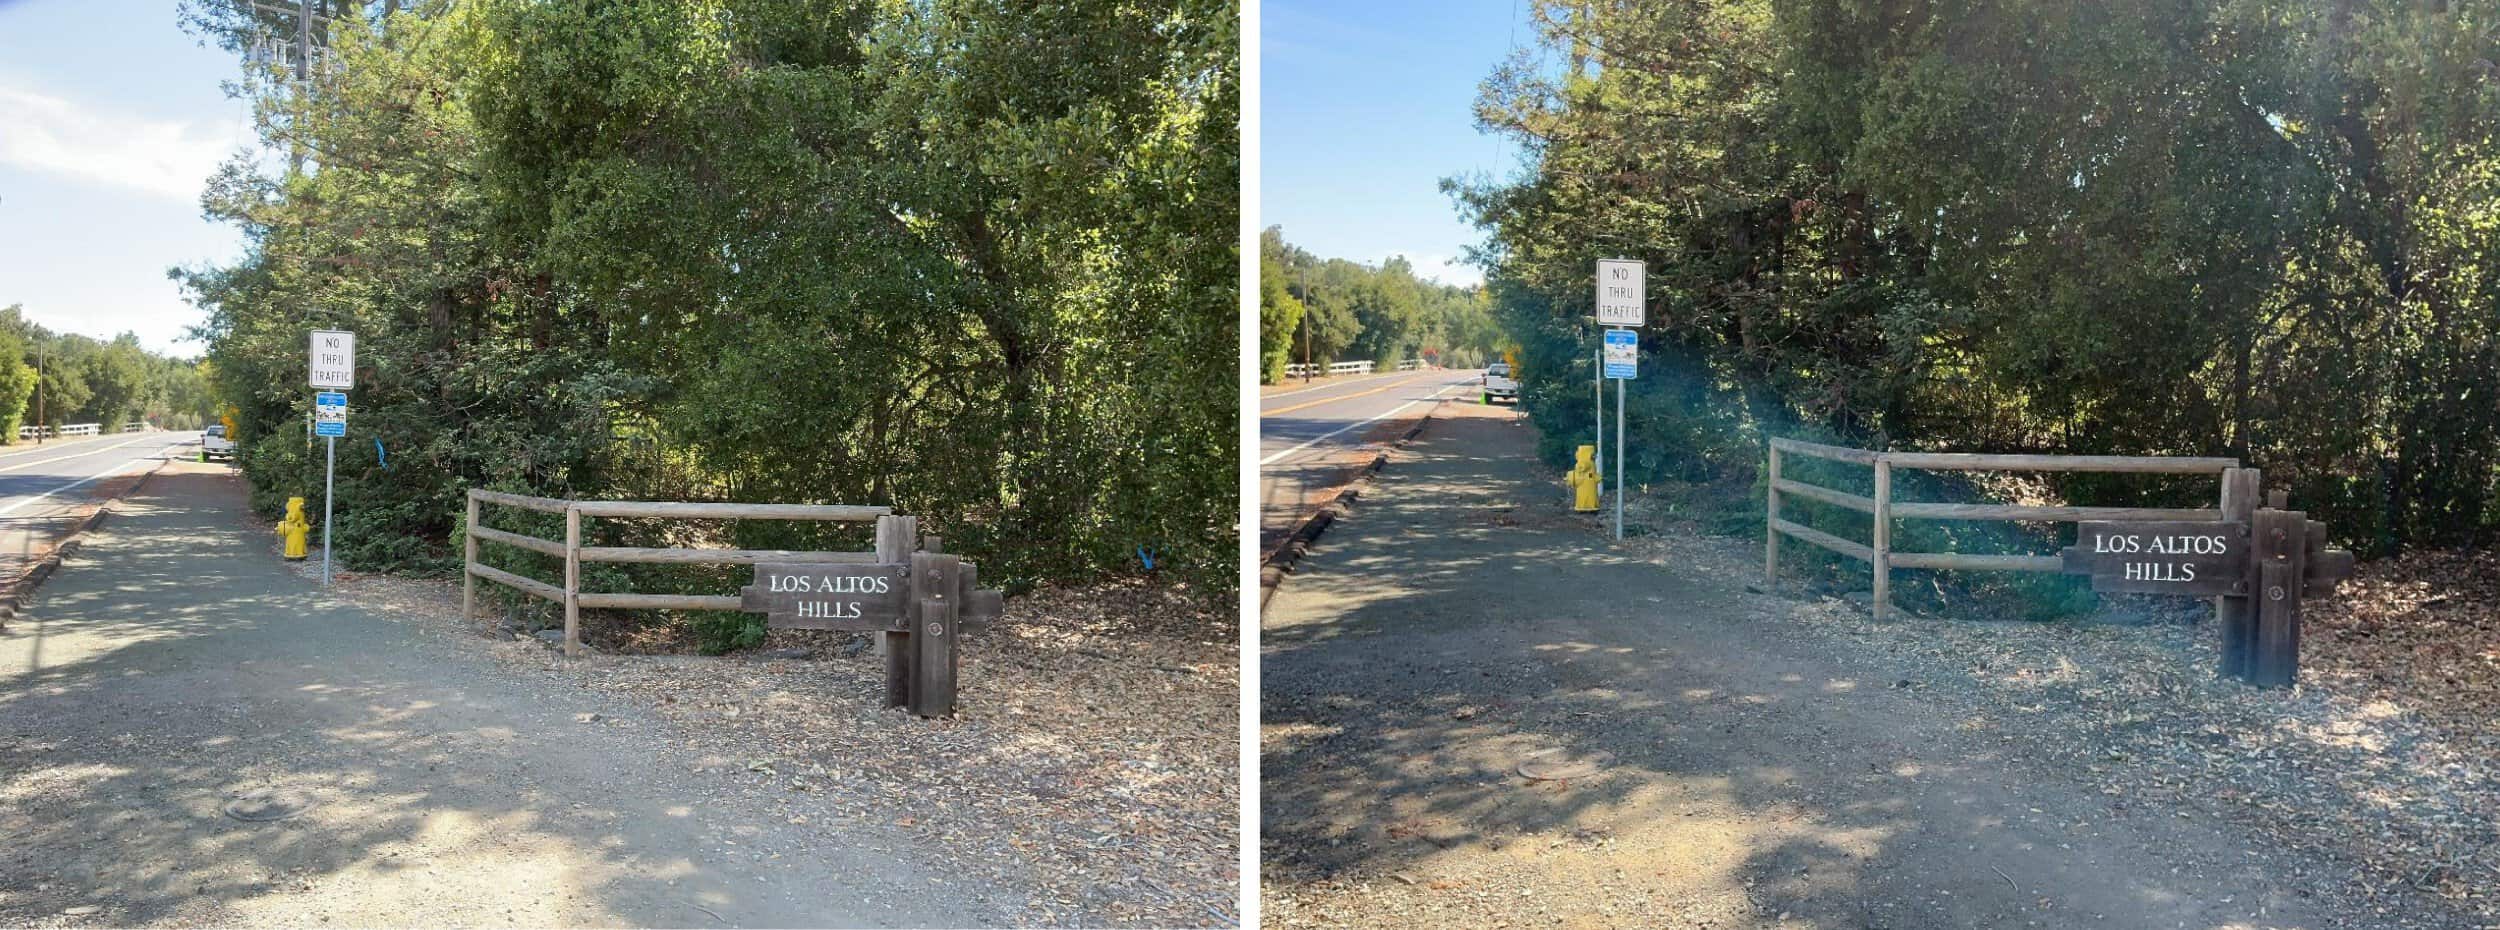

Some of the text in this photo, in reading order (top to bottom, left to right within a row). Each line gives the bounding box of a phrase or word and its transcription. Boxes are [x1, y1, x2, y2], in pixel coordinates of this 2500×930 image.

[1612, 267, 1629, 281] NO
[1608, 286, 1633, 299] THRU
[1601, 304, 1640, 319] TRAFFIC
[325, 337, 340, 349] NO
[322, 353, 344, 366] THRU
[314, 370, 351, 384] TRAFFIC
[2094, 534, 2227, 555] LOS ALTOS
[2125, 562, 2195, 582] HILLS
[770, 575, 889, 594] LOS ALTOS
[797, 601, 862, 619] HILLS
